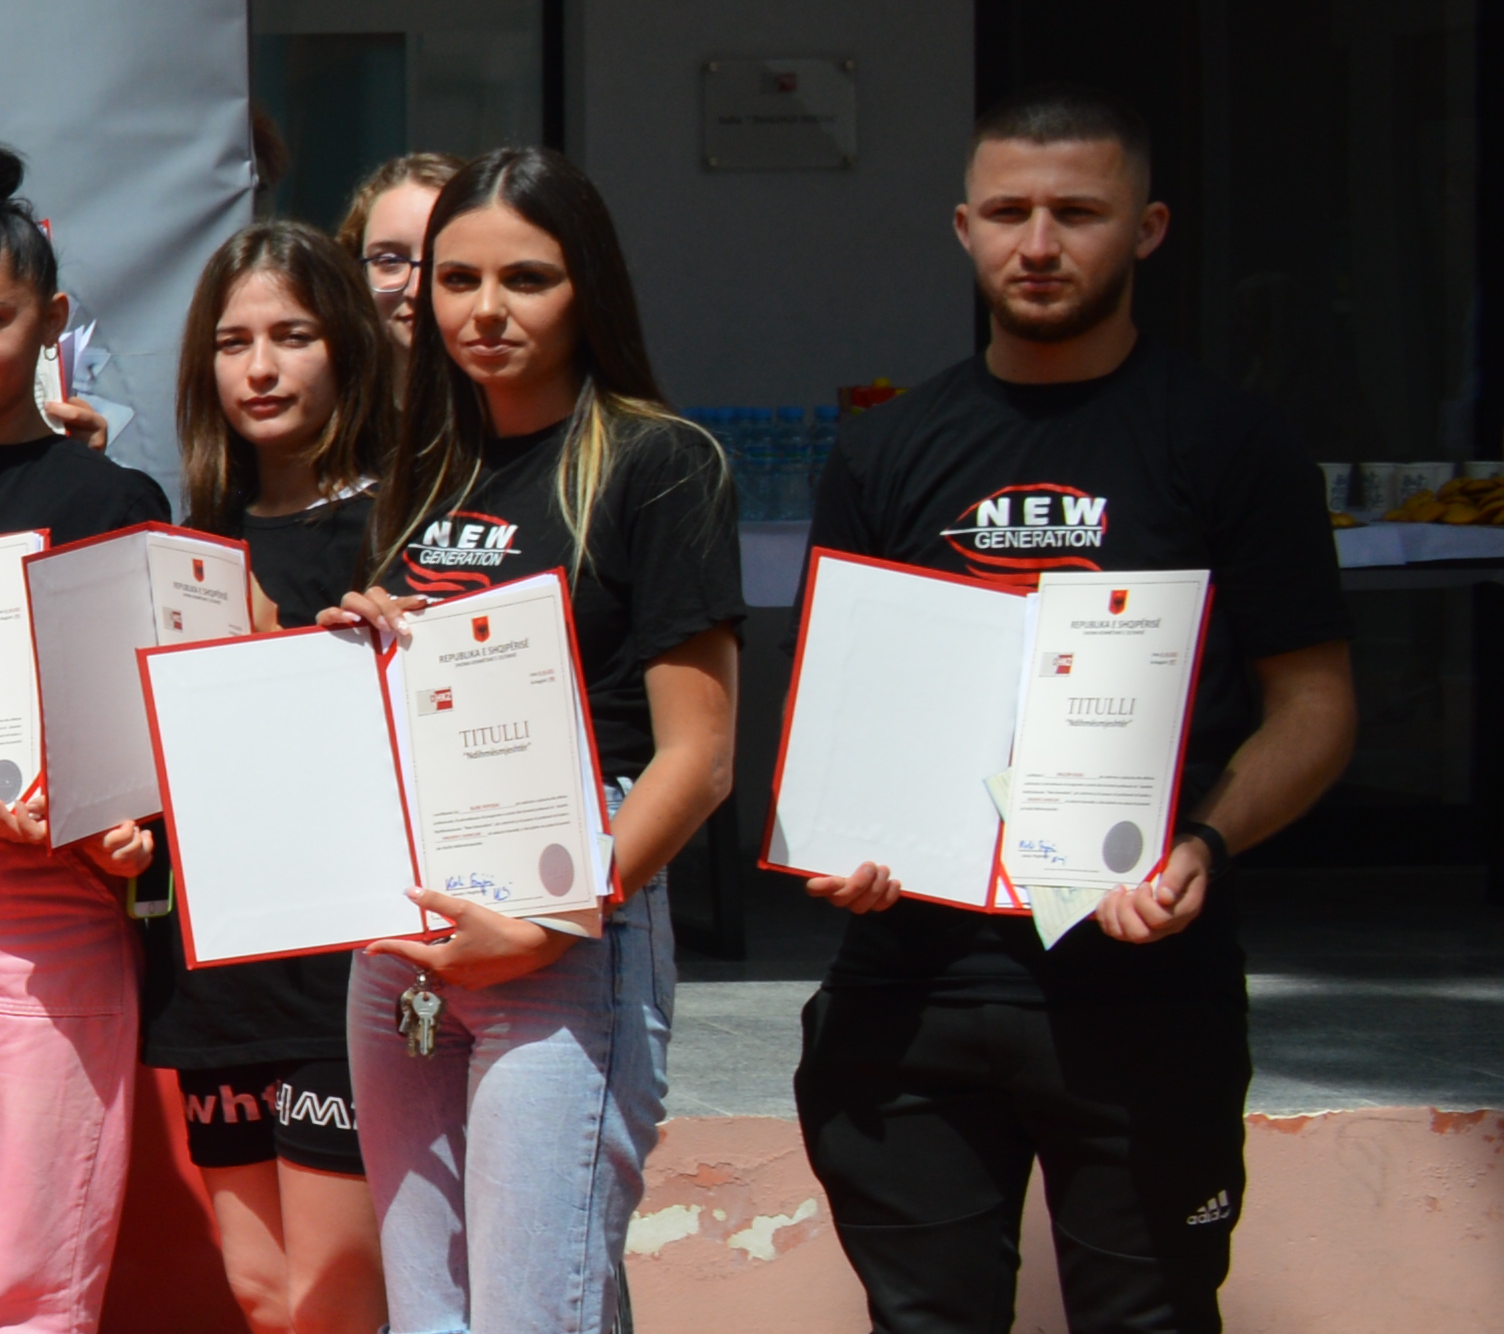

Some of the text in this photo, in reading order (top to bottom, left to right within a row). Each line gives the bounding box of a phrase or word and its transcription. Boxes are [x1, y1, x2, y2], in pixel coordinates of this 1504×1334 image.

[976, 496, 1107, 528] NEW
[422, 520, 520, 551] NEW
[974, 529, 1102, 549] GENERATION
[419, 549, 504, 567] GENERATION
[438, 649, 480, 665] REPUBLIKA
[1067, 697, 1137, 716] TITULLI
[459, 720, 530, 748] TITULLI
